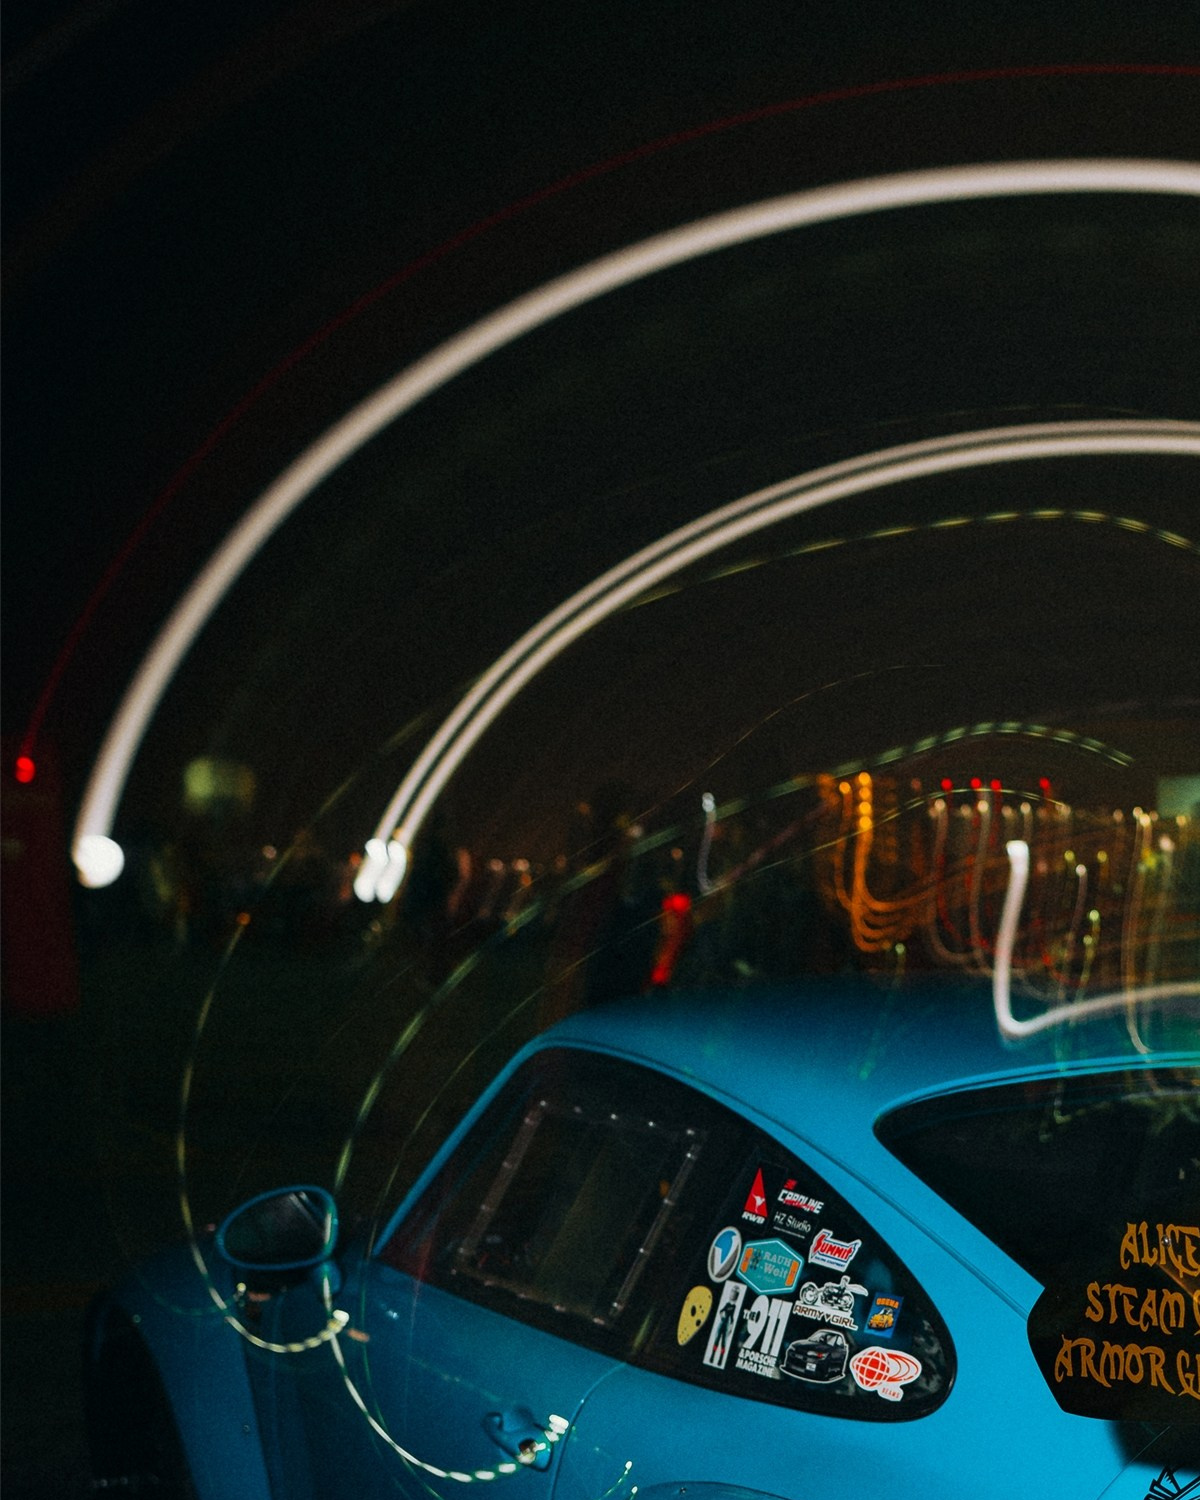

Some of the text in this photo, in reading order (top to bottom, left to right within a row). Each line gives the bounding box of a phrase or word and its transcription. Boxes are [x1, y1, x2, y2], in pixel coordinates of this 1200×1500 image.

[742, 1211, 765, 1225] RWB
[786, 1215, 811, 1232] Studio
[794, 1305, 857, 1330] ARMY GIRL
[1085, 1281, 1186, 1335] STEAM
[742, 1294, 793, 1358] 911
[735, 1358, 774, 1378] MAGAZINE
[1054, 1334, 1176, 1395] ARMOR
[881, 1387, 900, 1399] BEAMS
